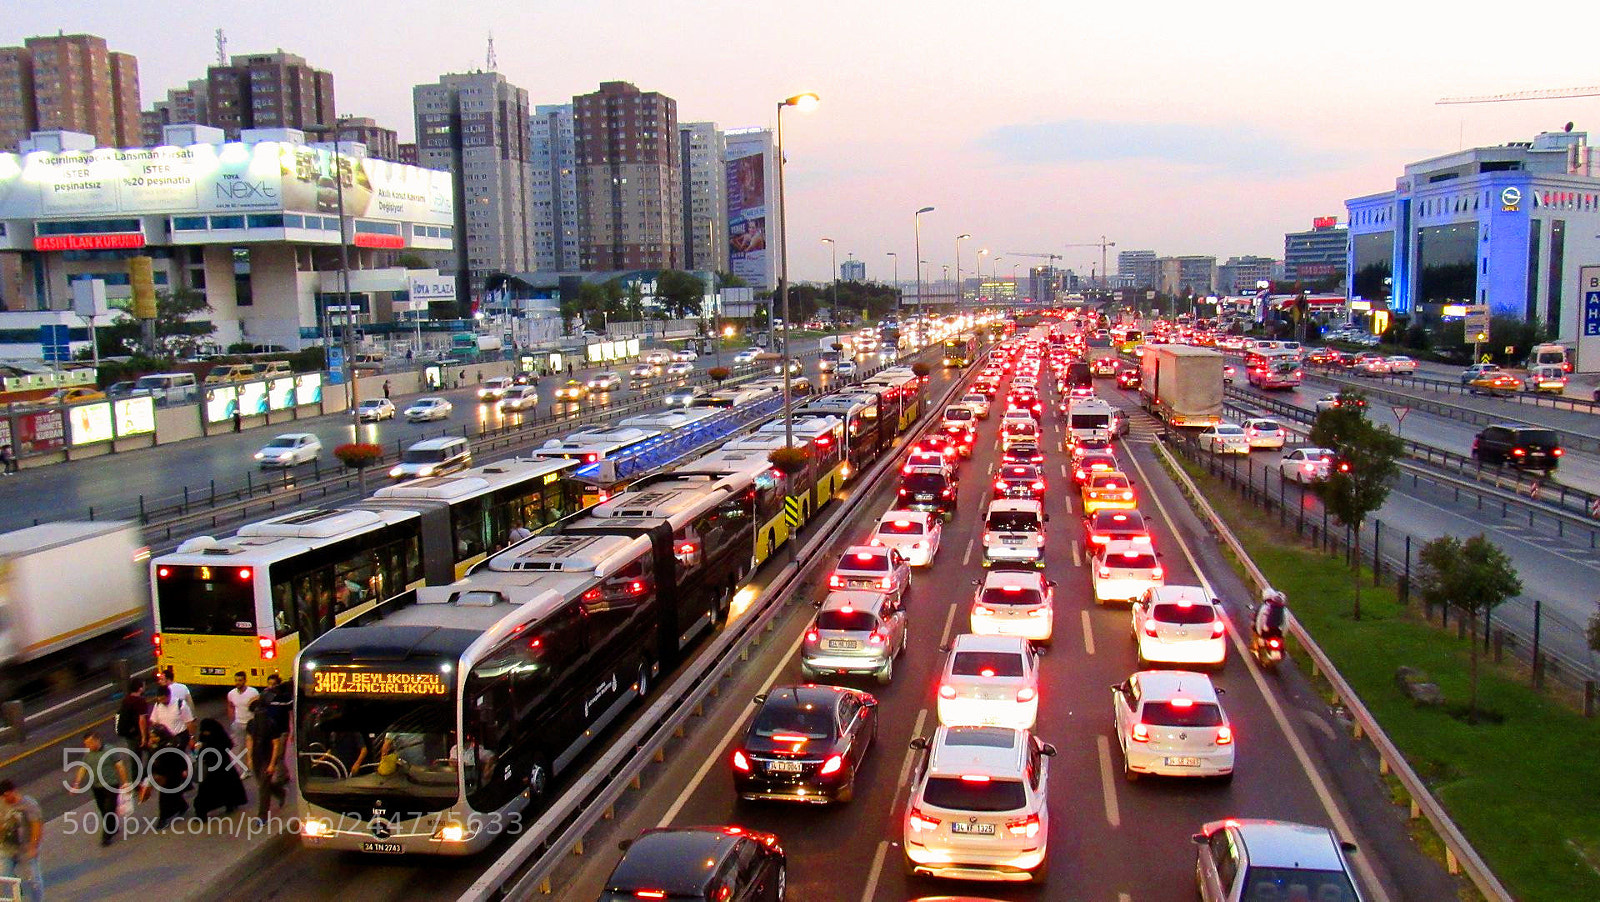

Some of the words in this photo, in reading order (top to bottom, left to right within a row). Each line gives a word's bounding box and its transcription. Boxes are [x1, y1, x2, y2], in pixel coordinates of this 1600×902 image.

[114, 149, 159, 161] Lansman
[54, 181, 101, 193] peşinatsız
[123, 177, 144, 187] %20
[432, 284, 454, 294] PLAZA
[314, 672, 347, 693] 34BZ
[365, 843, 374, 851] 34
